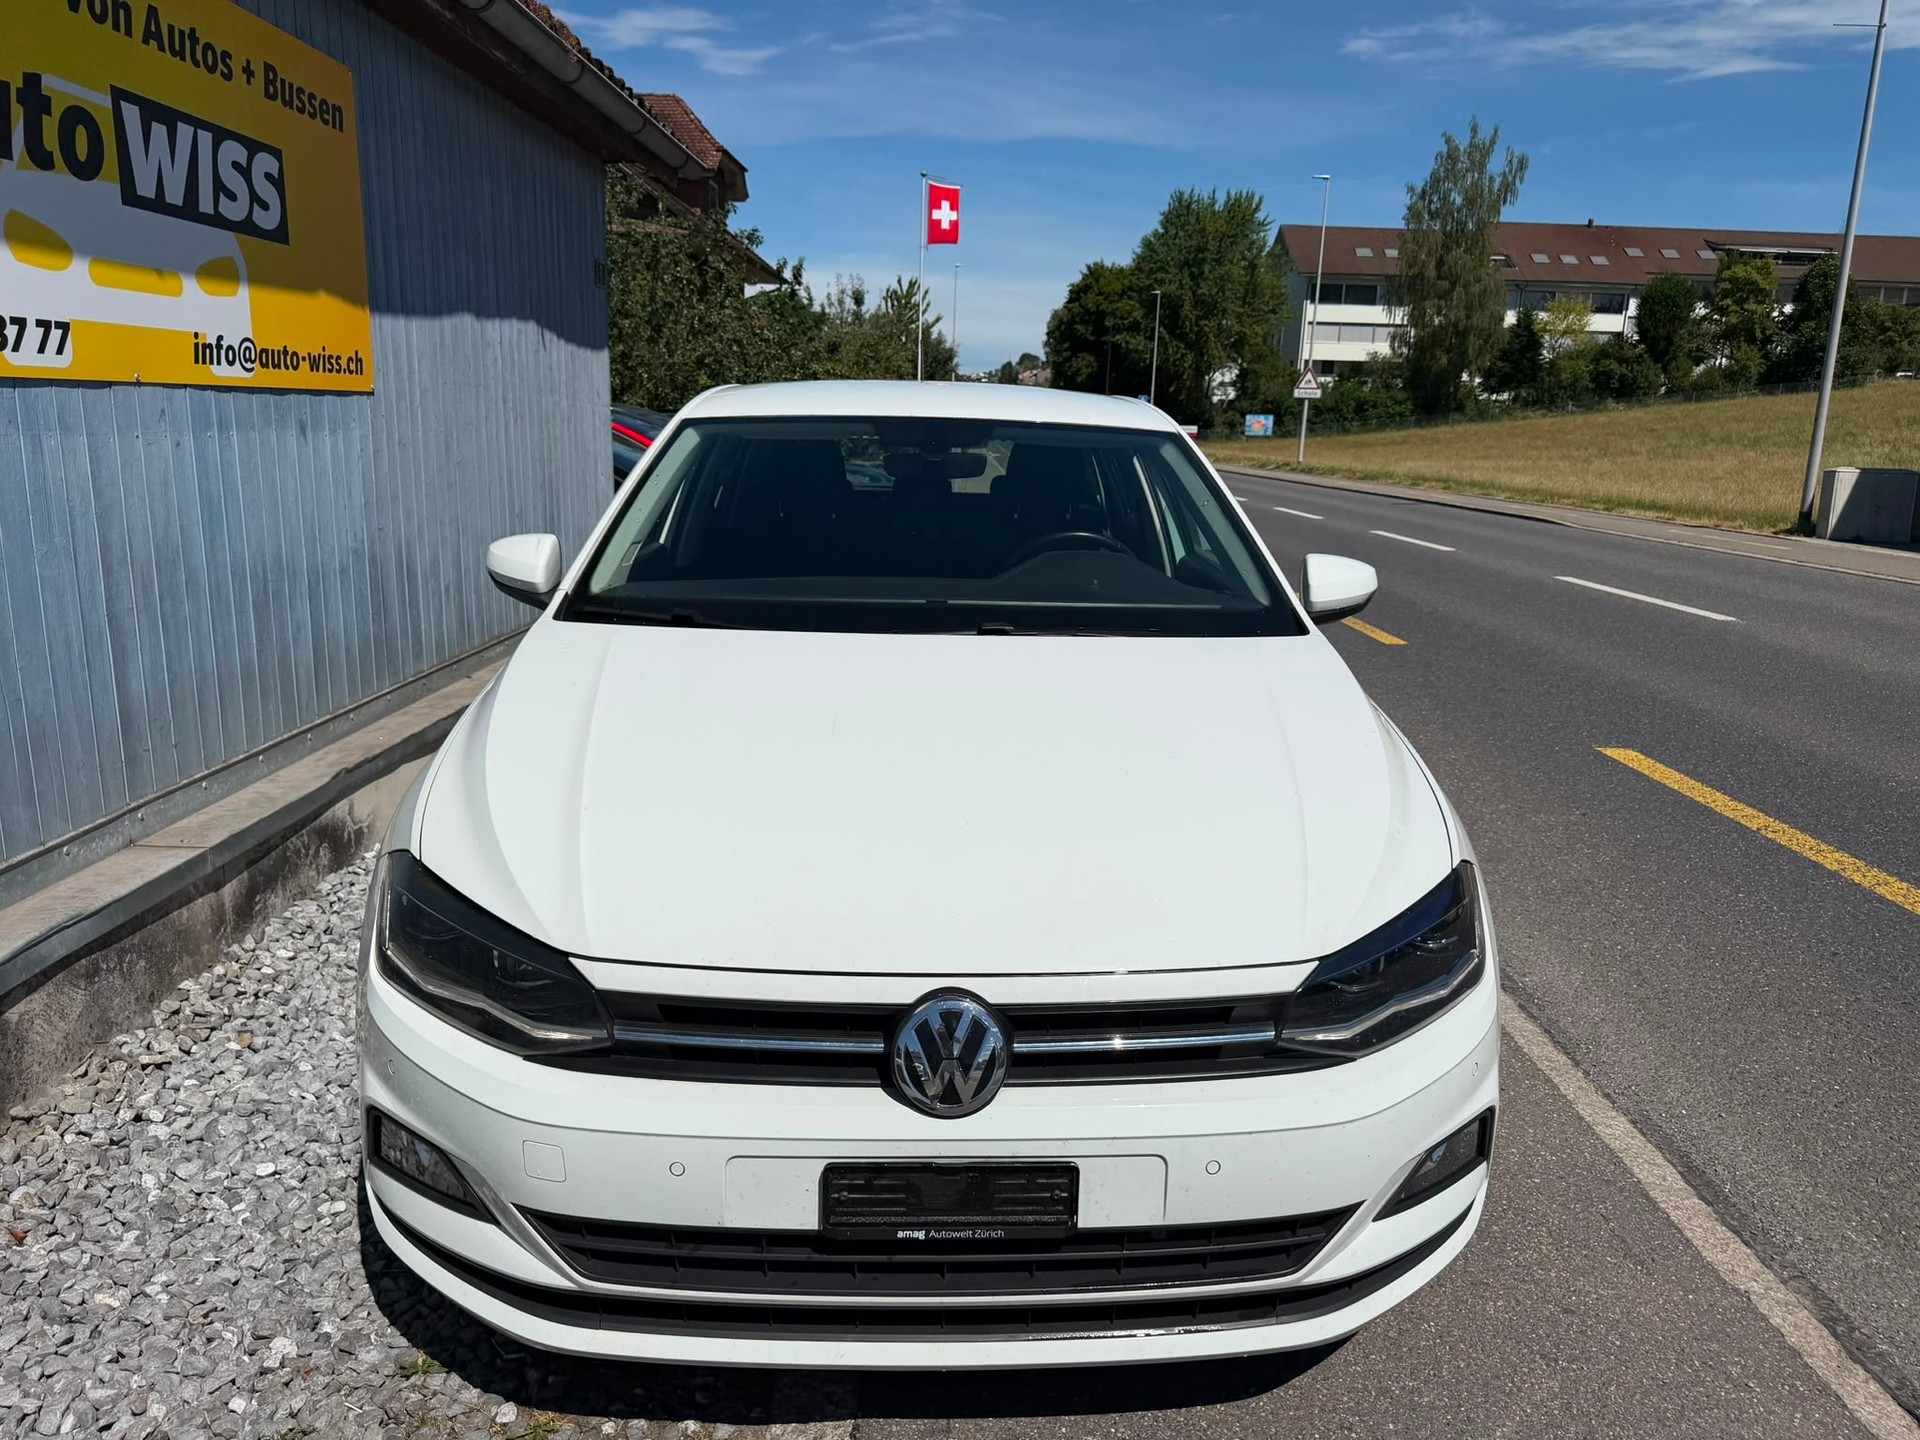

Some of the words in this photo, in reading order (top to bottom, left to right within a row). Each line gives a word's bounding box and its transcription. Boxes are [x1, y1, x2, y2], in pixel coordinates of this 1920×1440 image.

[141, 4, 233, 82] Autos
[242, 59, 255, 86] +
[263, 61, 344, 133] Bussen
[0, 71, 105, 182] to
[119, 100, 282, 231] WISS
[35, 318, 71, 356] 77
[193, 333, 364, 376] info@auto-wiss.ch
[898, 1000, 1002, 1110] VW
[897, 1230, 926, 1240] amag
[929, 1229, 973, 1239] Autowelt
[974, 1229, 1005, 1239] Zürich
